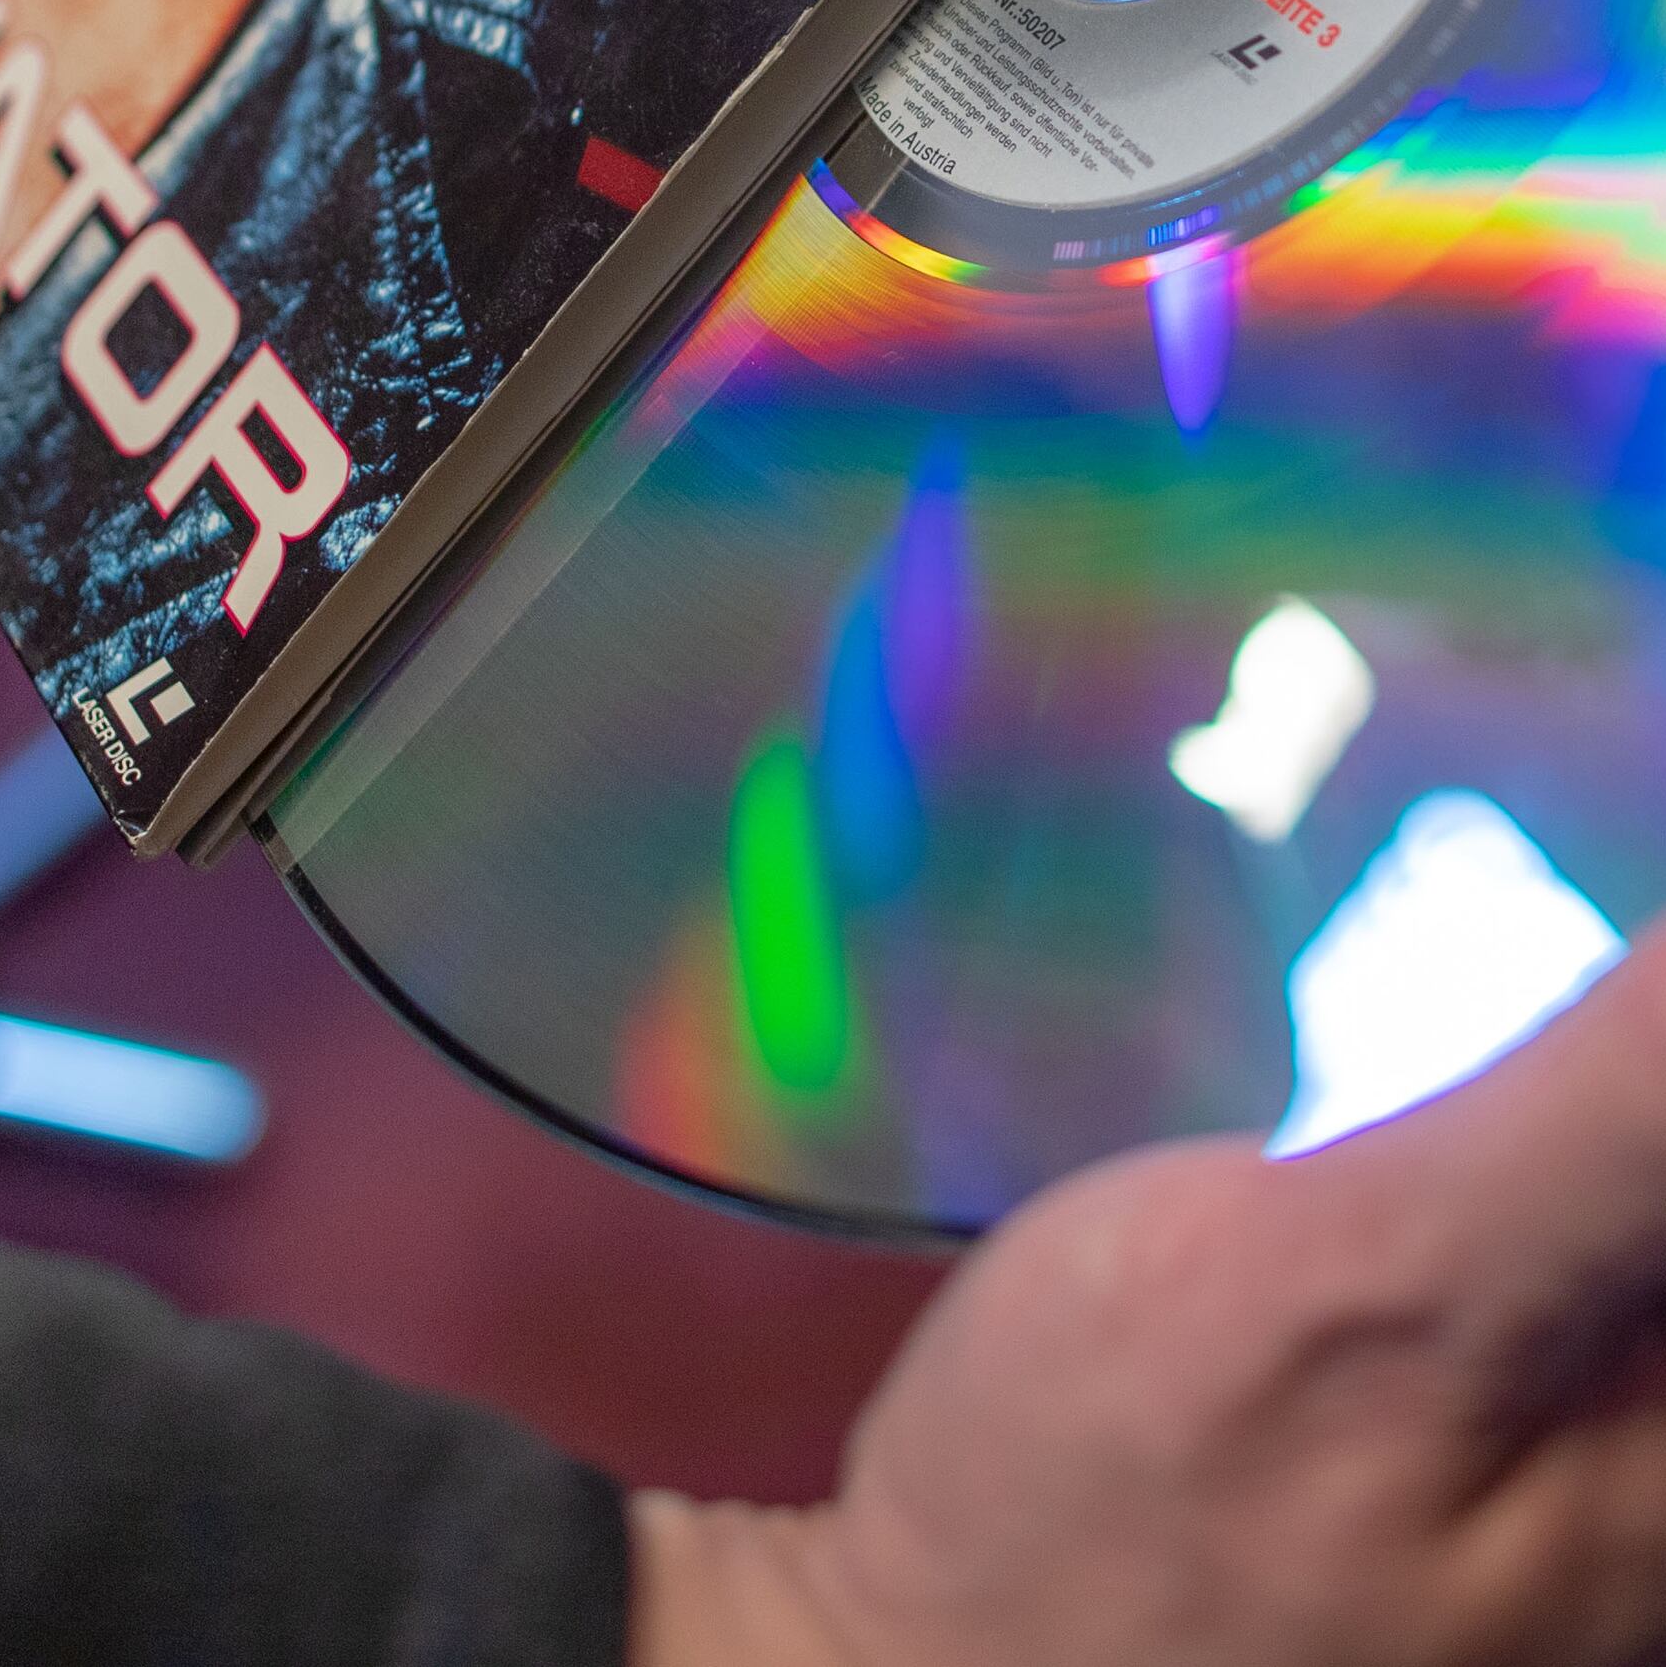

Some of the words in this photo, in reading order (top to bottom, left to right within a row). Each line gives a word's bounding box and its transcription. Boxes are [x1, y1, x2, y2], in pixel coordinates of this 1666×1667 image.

[987, 17, 1032, 61] Programm
[1028, 55, 1055, 79] (Bild
[1079, 98, 1095, 117] ist
[1091, 111, 1111, 129] nur
[1317, 24, 1341, 49] 3
[858, 75, 893, 124] Made
[887, 115, 905, 137] in
[900, 130, 957, 176] Austria
[902, 96, 935, 129] verfolgt
[907, 48, 986, 124] Zuwiderhandlungen
[983, 120, 1017, 153] werden
[921, 88, 973, 139] strafrechtlich
[932, 48, 953, 66] und
[950, 60, 1011, 123] Vervielfältigung
[1008, 117, 1032, 138] sind
[1027, 134, 1053, 159] nicht
[950, 38, 972, 58] oder
[968, 53, 1012, 96] Rückkauf,
[1009, 91, 1037, 117] sowie
[1034, 112, 1080, 157] öffentliche
[990, 47, 1083, 133] Leistungsschutzrechte
[71, 686, 116, 746] LASER
[104, 739, 142, 786] DISC
